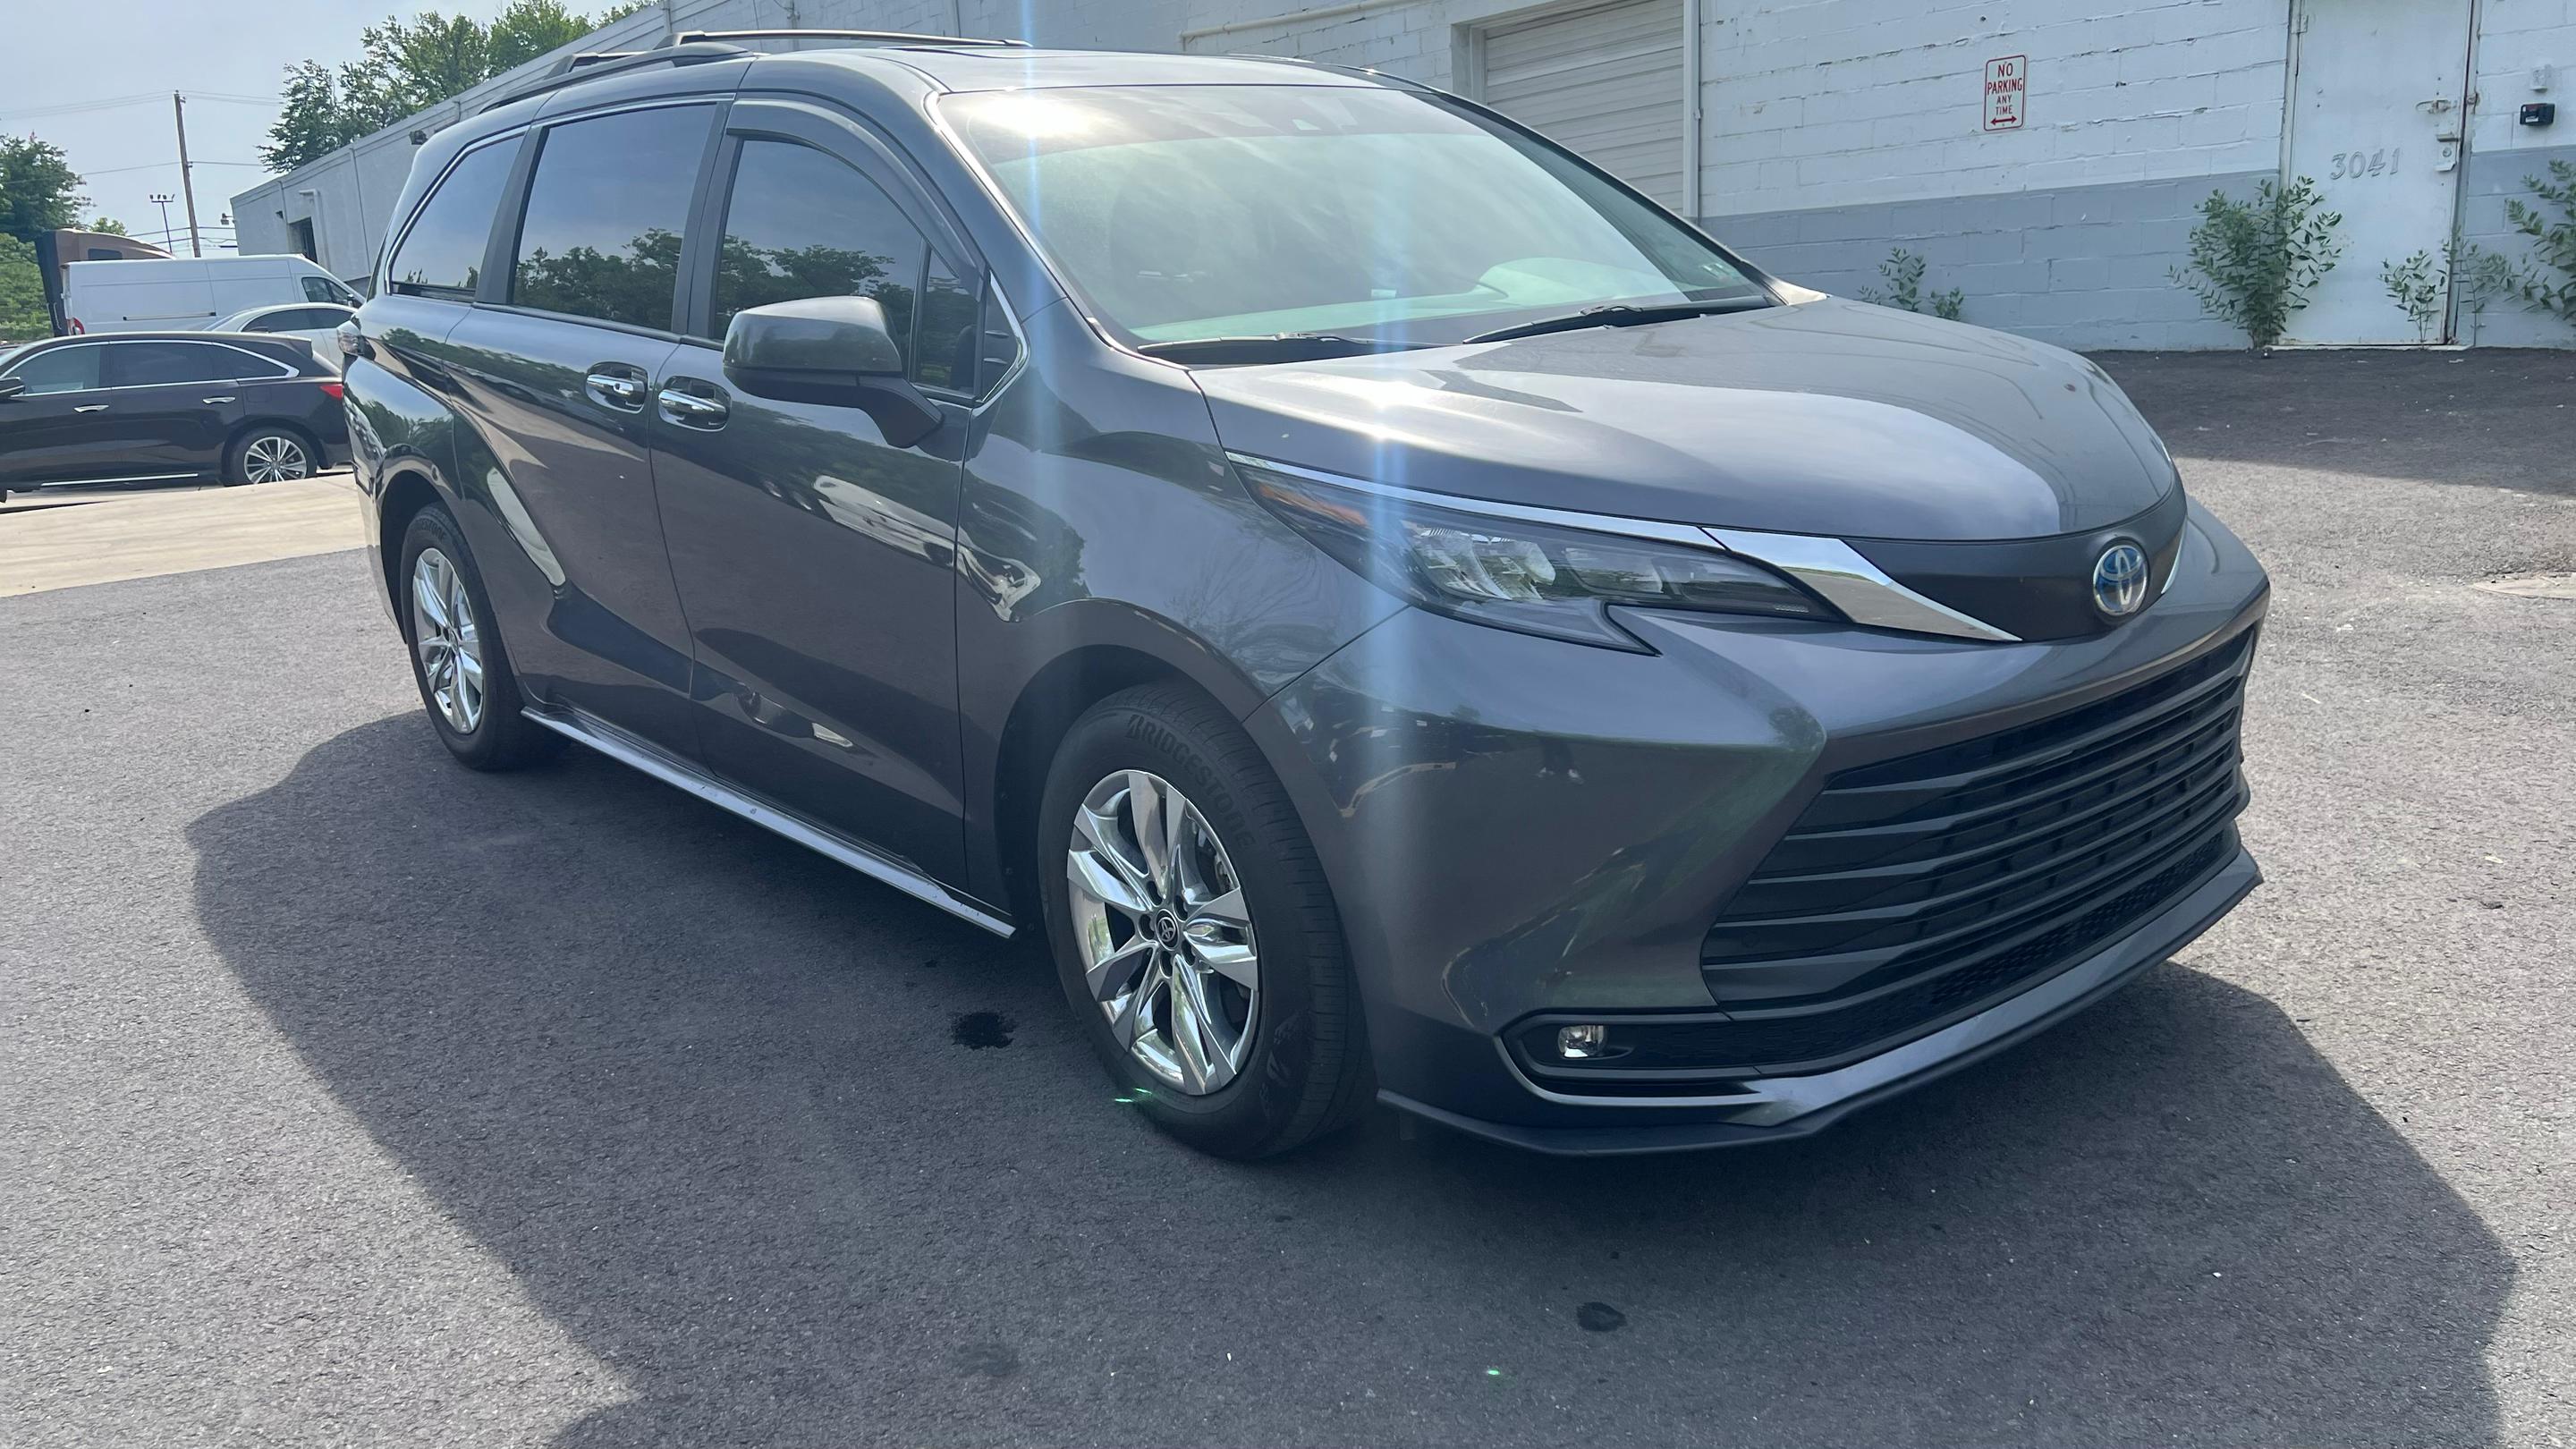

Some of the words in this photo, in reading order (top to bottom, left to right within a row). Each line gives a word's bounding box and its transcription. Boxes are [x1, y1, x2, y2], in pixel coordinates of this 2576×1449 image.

[1997, 63, 2013, 78] NO
[1987, 78, 2022, 95] PARKING
[1996, 95, 2012, 105] ANY
[1996, 105, 2012, 115] TIME
[2330, 148, 2400, 180] 3041
